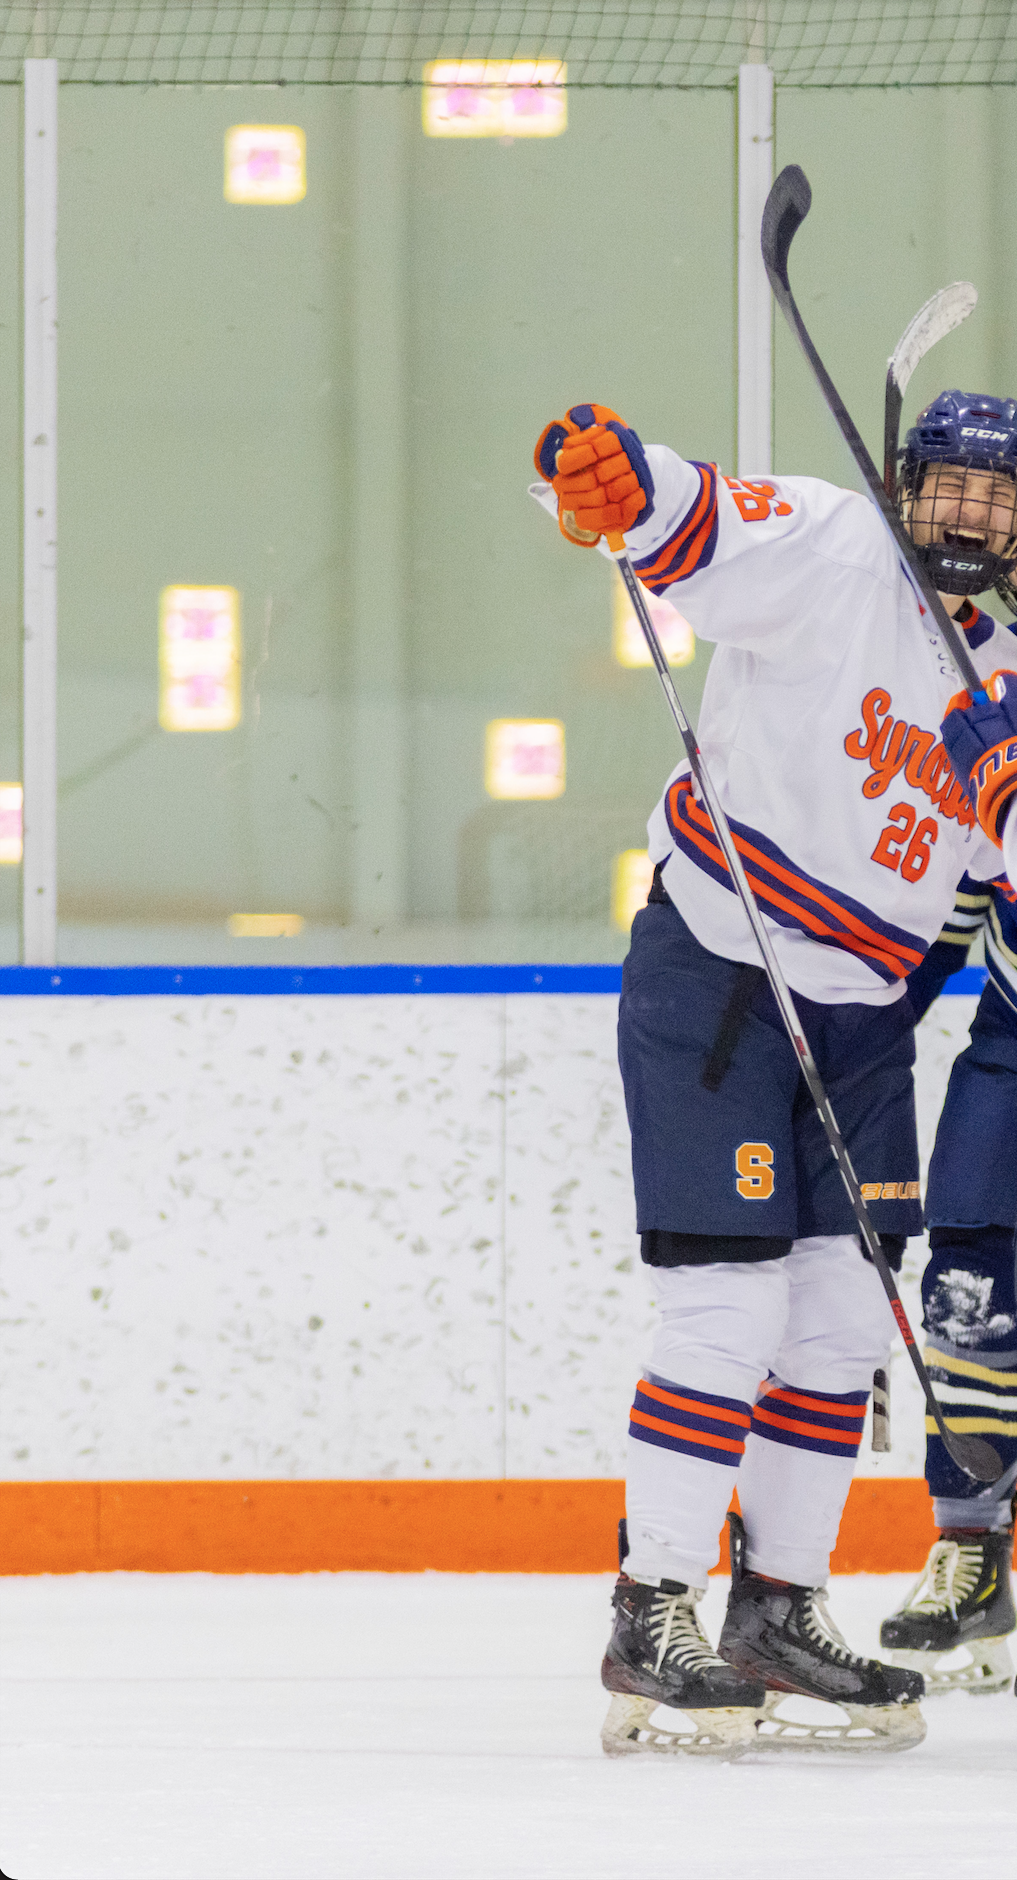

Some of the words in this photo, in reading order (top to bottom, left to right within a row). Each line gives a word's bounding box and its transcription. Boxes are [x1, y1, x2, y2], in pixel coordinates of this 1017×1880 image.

[960, 426, 1009, 442] CCM
[941, 558, 984, 572] CCM
[870, 801, 938, 884] 26
[735, 1141, 776, 1200] S
